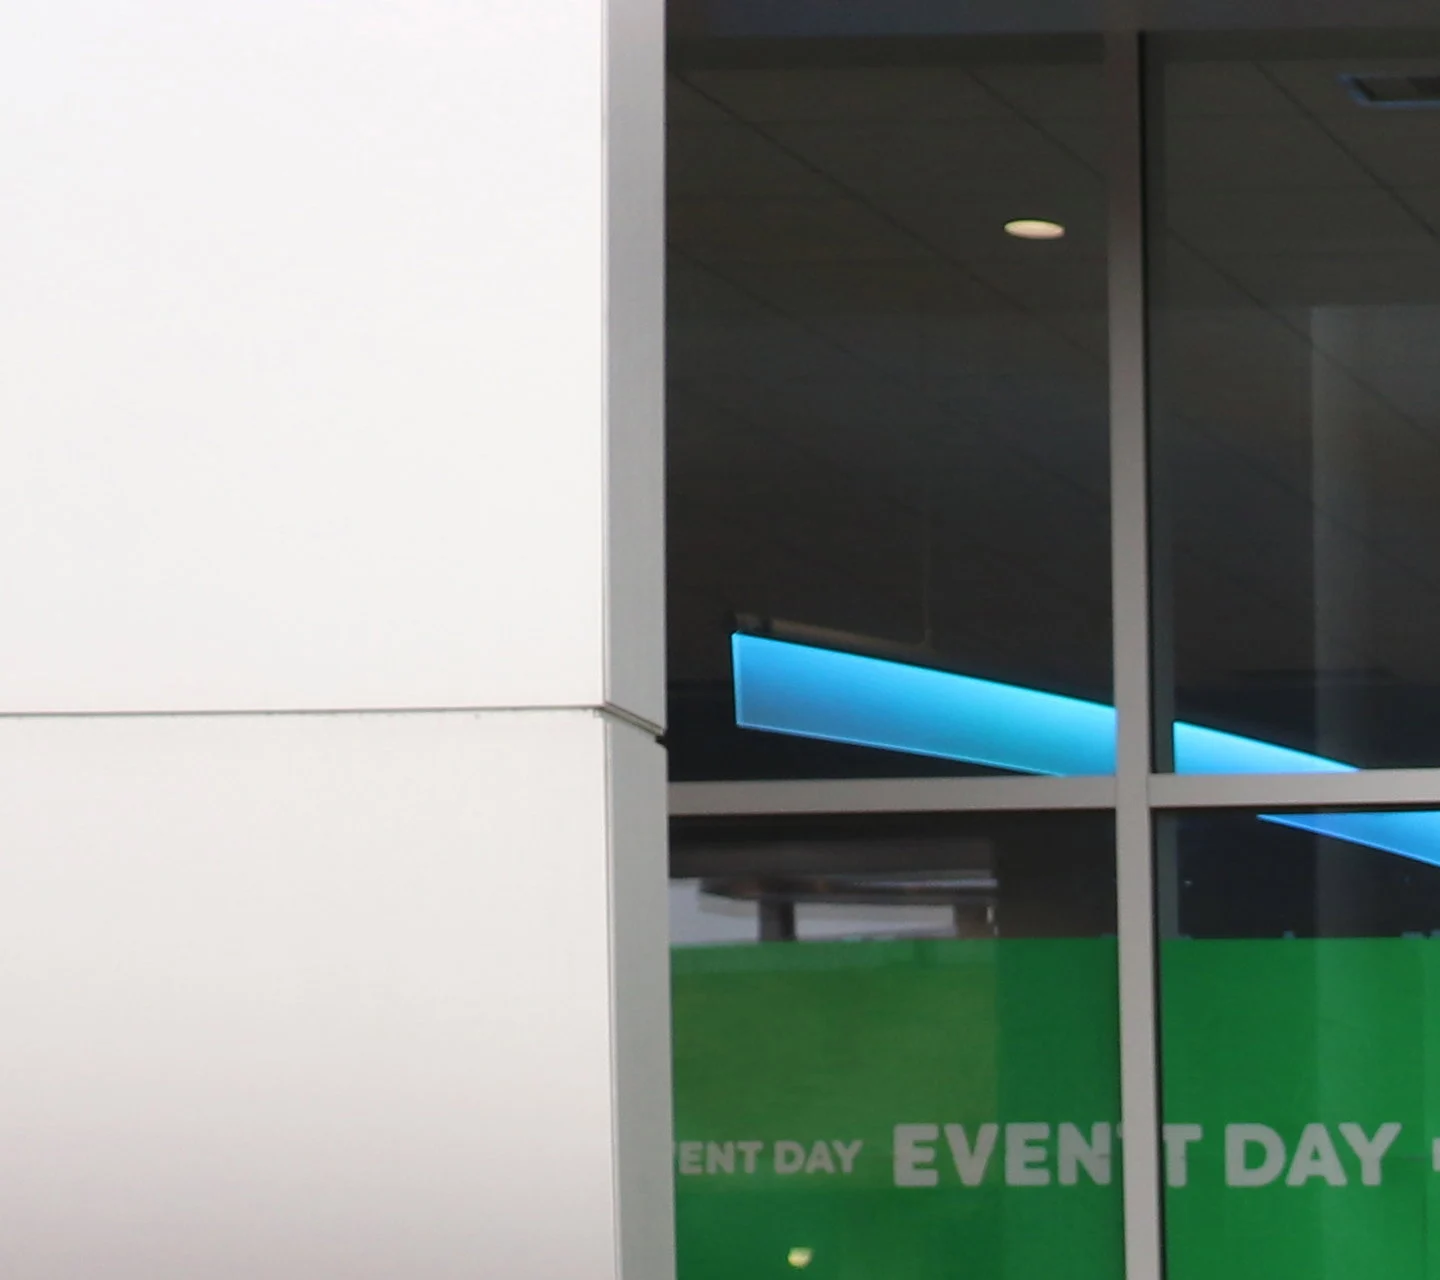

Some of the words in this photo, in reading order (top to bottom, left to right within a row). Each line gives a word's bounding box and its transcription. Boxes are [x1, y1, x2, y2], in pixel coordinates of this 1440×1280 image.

[675, 1140, 764, 1176] ENT
[773, 1140, 865, 1175] DAY
[892, 1121, 1204, 1188] EVENT
[1223, 1121, 1403, 1187] DAY
